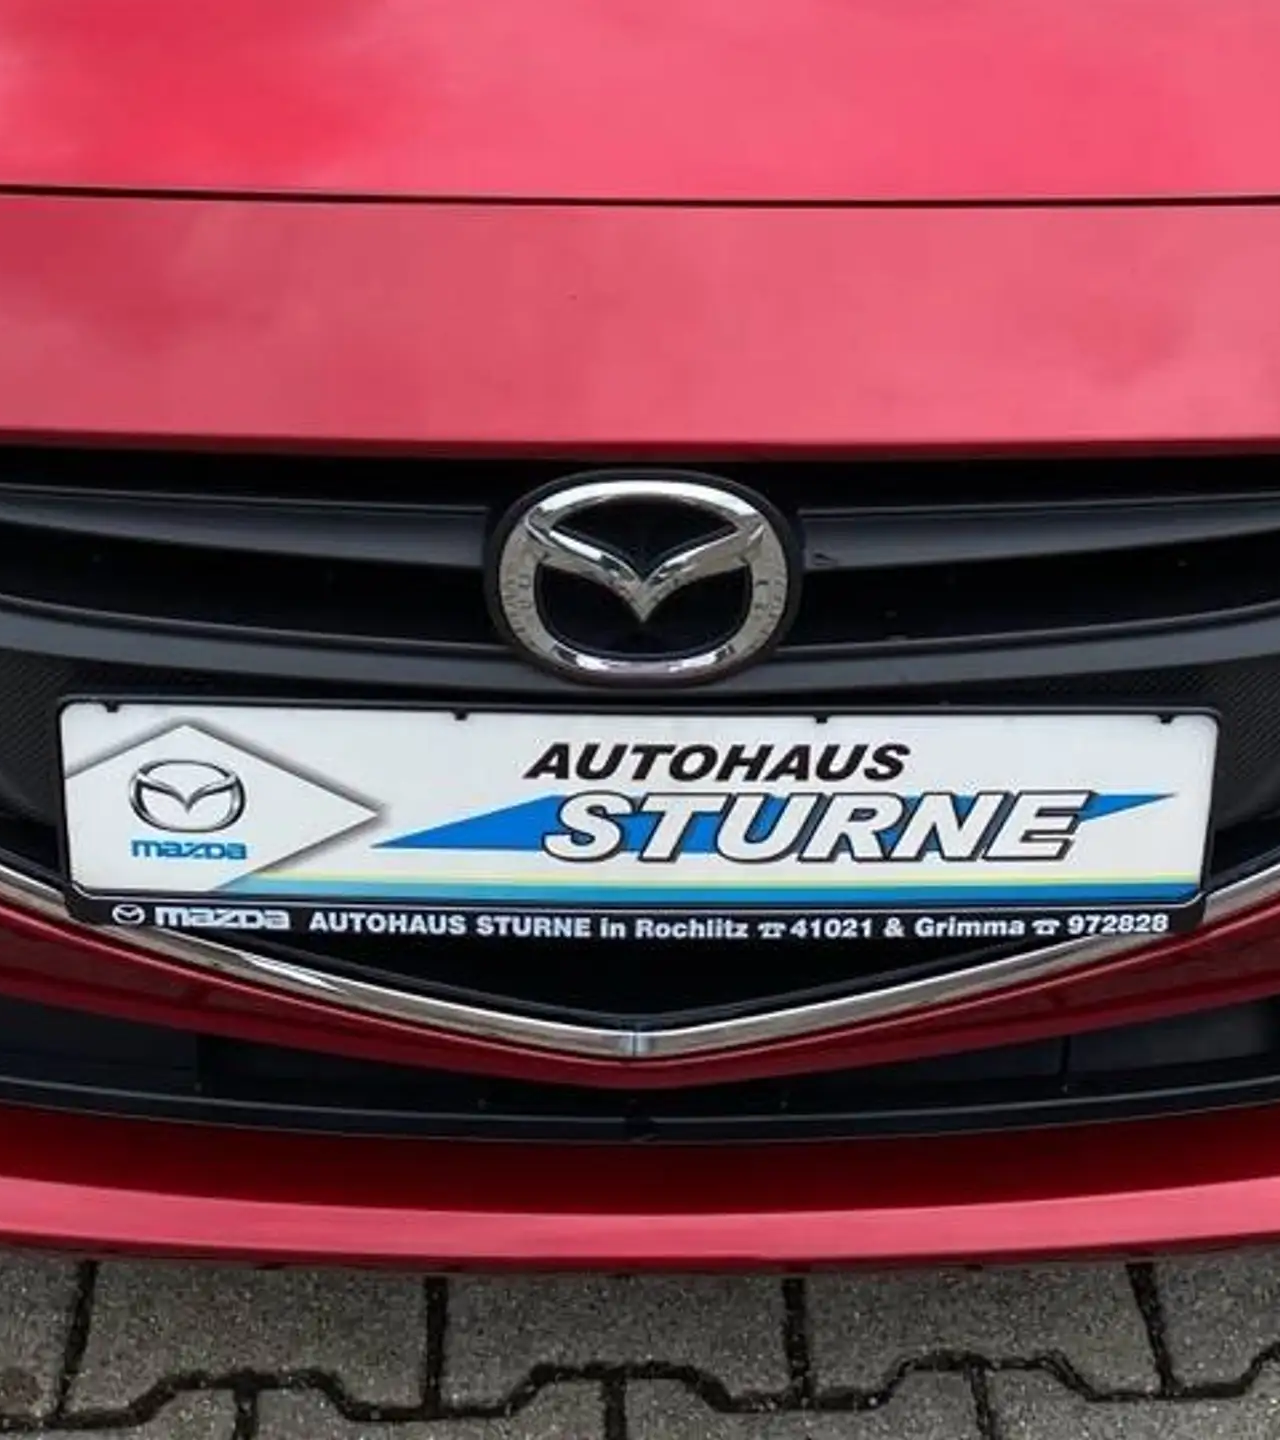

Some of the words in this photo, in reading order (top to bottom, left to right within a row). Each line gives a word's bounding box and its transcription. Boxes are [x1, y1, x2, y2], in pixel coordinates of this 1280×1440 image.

[524, 743, 911, 782] AUTOHAUS
[541, 790, 1095, 862] STURNE
[130, 838, 249, 861] mazda
[154, 906, 291, 930] mazda
[308, 911, 467, 936] AUTOHAUS
[476, 914, 591, 938] STURNE
[634, 917, 749, 940] Rochlitz
[790, 918, 872, 939] 41021
[883, 918, 906, 938] &
[914, 916, 1025, 938] Grimma
[1067, 914, 1169, 935] 972828
